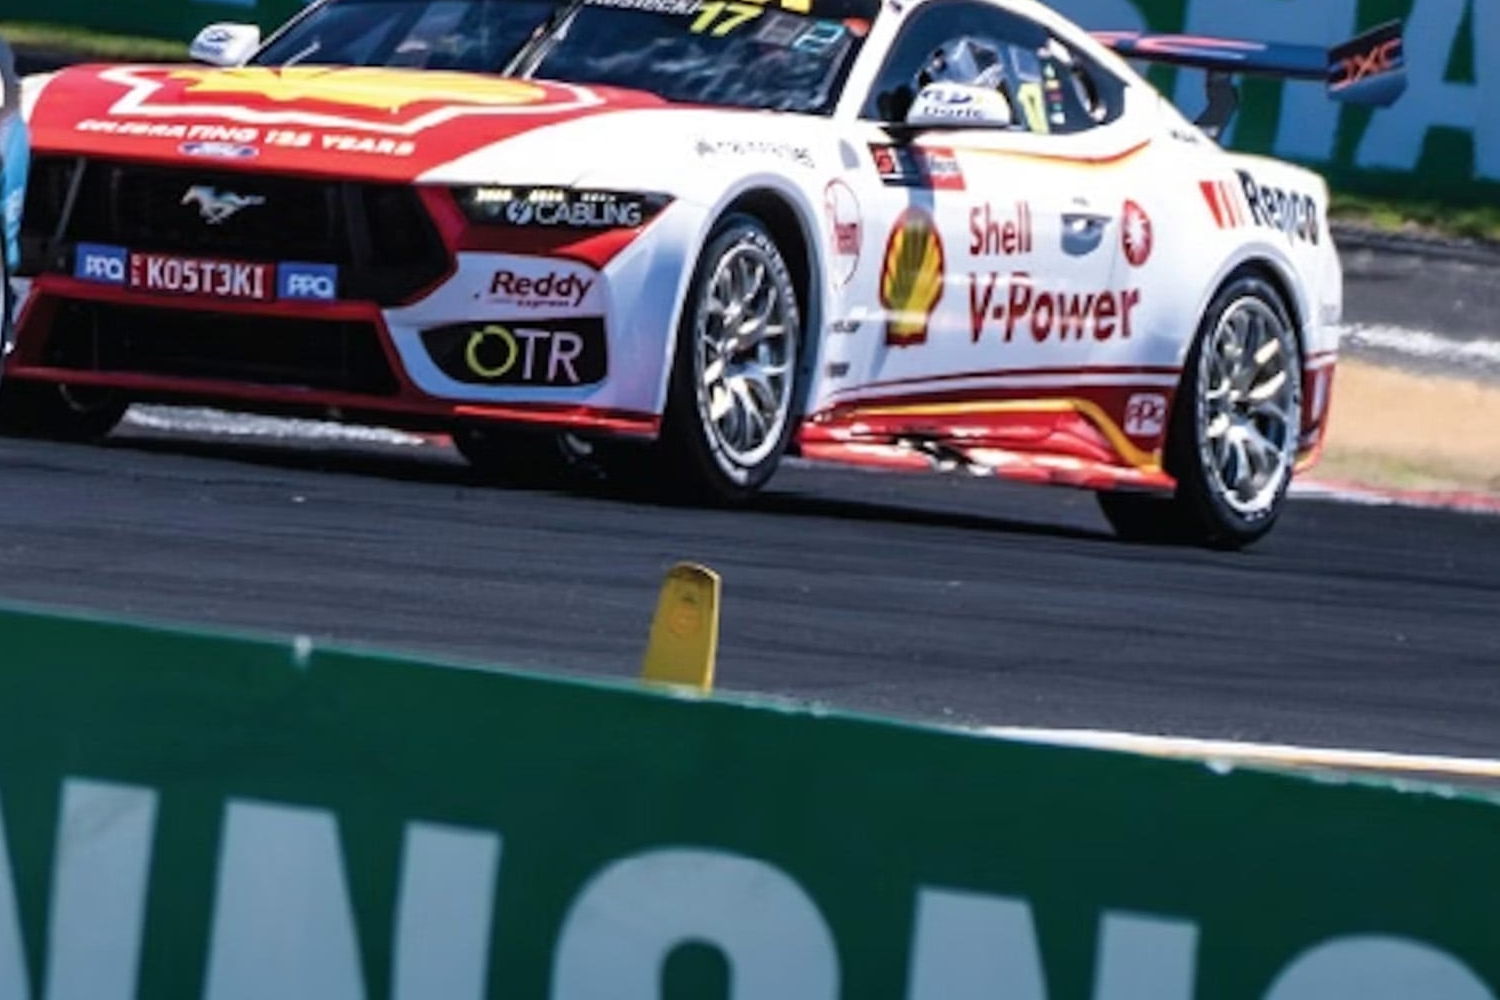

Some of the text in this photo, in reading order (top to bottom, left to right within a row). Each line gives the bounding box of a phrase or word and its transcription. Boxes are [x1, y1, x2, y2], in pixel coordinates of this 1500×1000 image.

[690, 1, 765, 37] 17
[320, 134, 416, 156] YEARS
[535, 203, 641, 226] CABLING
[969, 199, 1033, 257] Shell
[489, 270, 593, 306] Reddy
[969, 271, 1141, 343] V-Power
[465, 324, 581, 383] OTR
